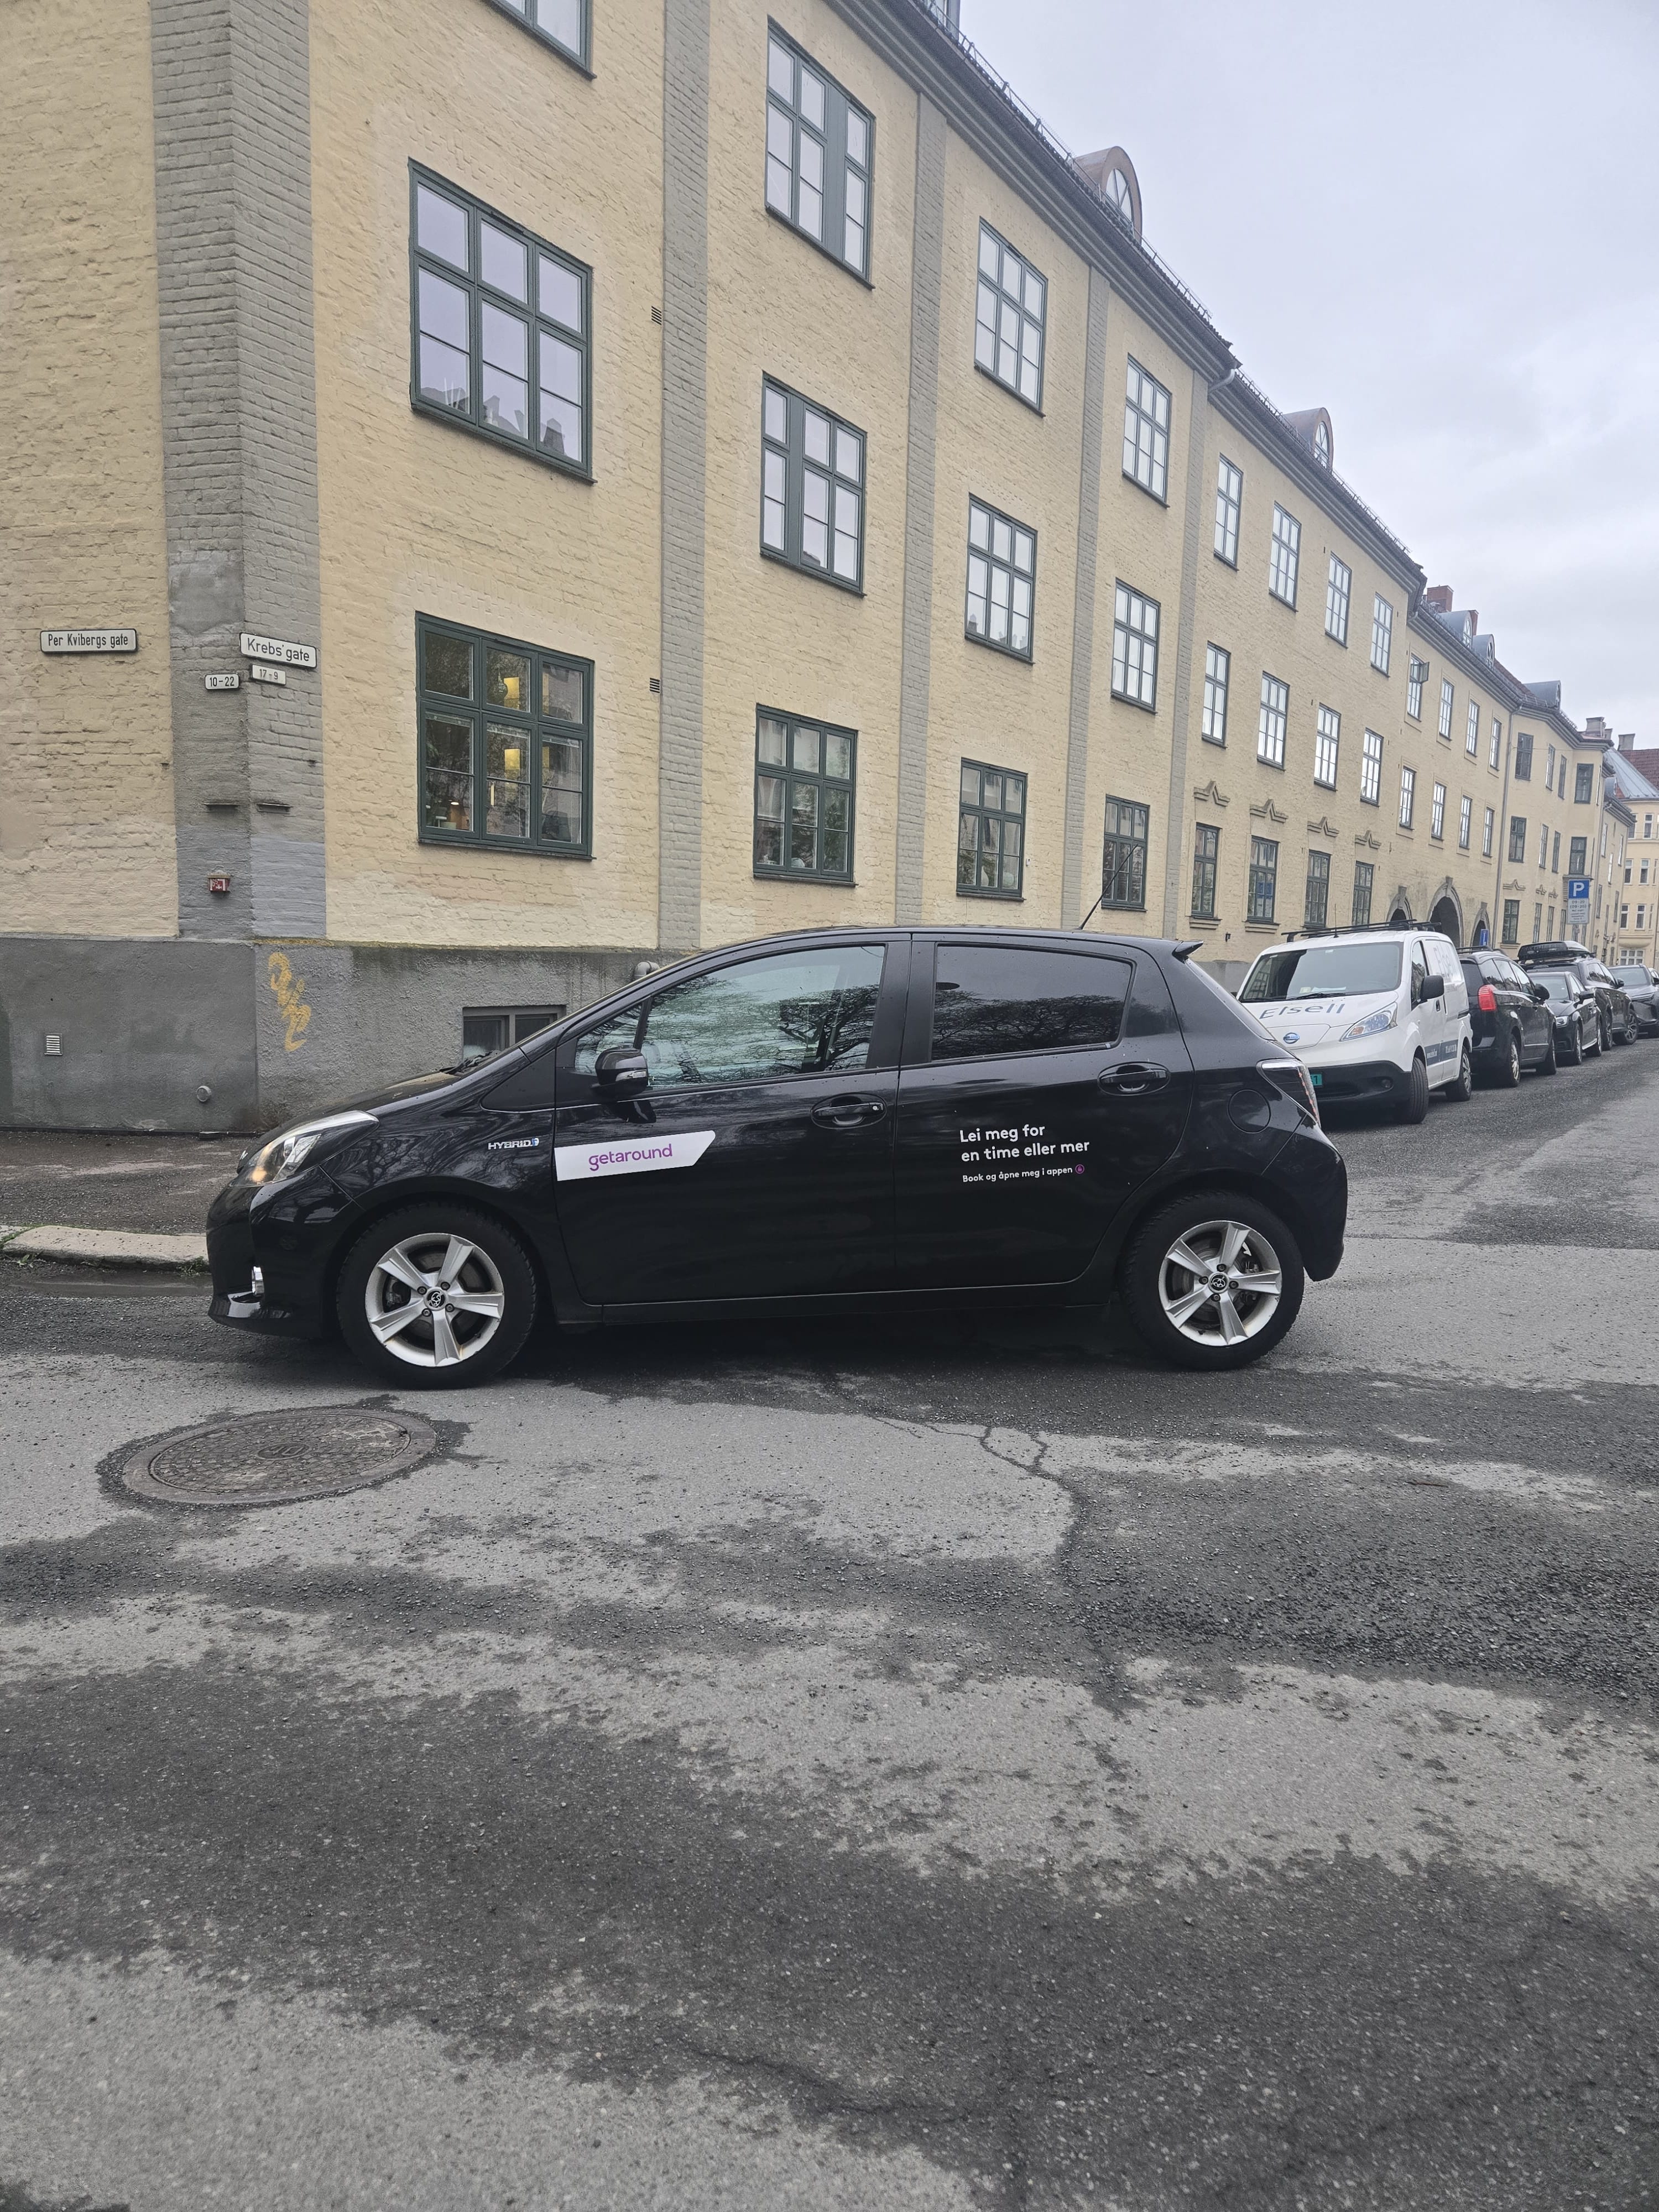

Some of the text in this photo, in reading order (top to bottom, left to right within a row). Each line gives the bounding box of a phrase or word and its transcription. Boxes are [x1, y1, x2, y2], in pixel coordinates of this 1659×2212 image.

[48, 633, 128, 649] Per Kvibergs gate
[286, 648, 310, 661] gate
[1573, 882, 1585, 897] P
[1259, 1003, 1345, 1019] Elsell
[959, 1124, 1045, 1142] Lei meg for
[488, 1140, 531, 1150] HYBRID
[961, 1141, 1089, 1162] en time eller mer
[588, 1144, 673, 1171] getaround
[962, 1174, 984, 1182] Book
[985, 1173, 997, 1182] og
[999, 1171, 1019, 1181] åpne
[1021, 1170, 1040, 1178] meg
[1046, 1167, 1073, 1176] appen
